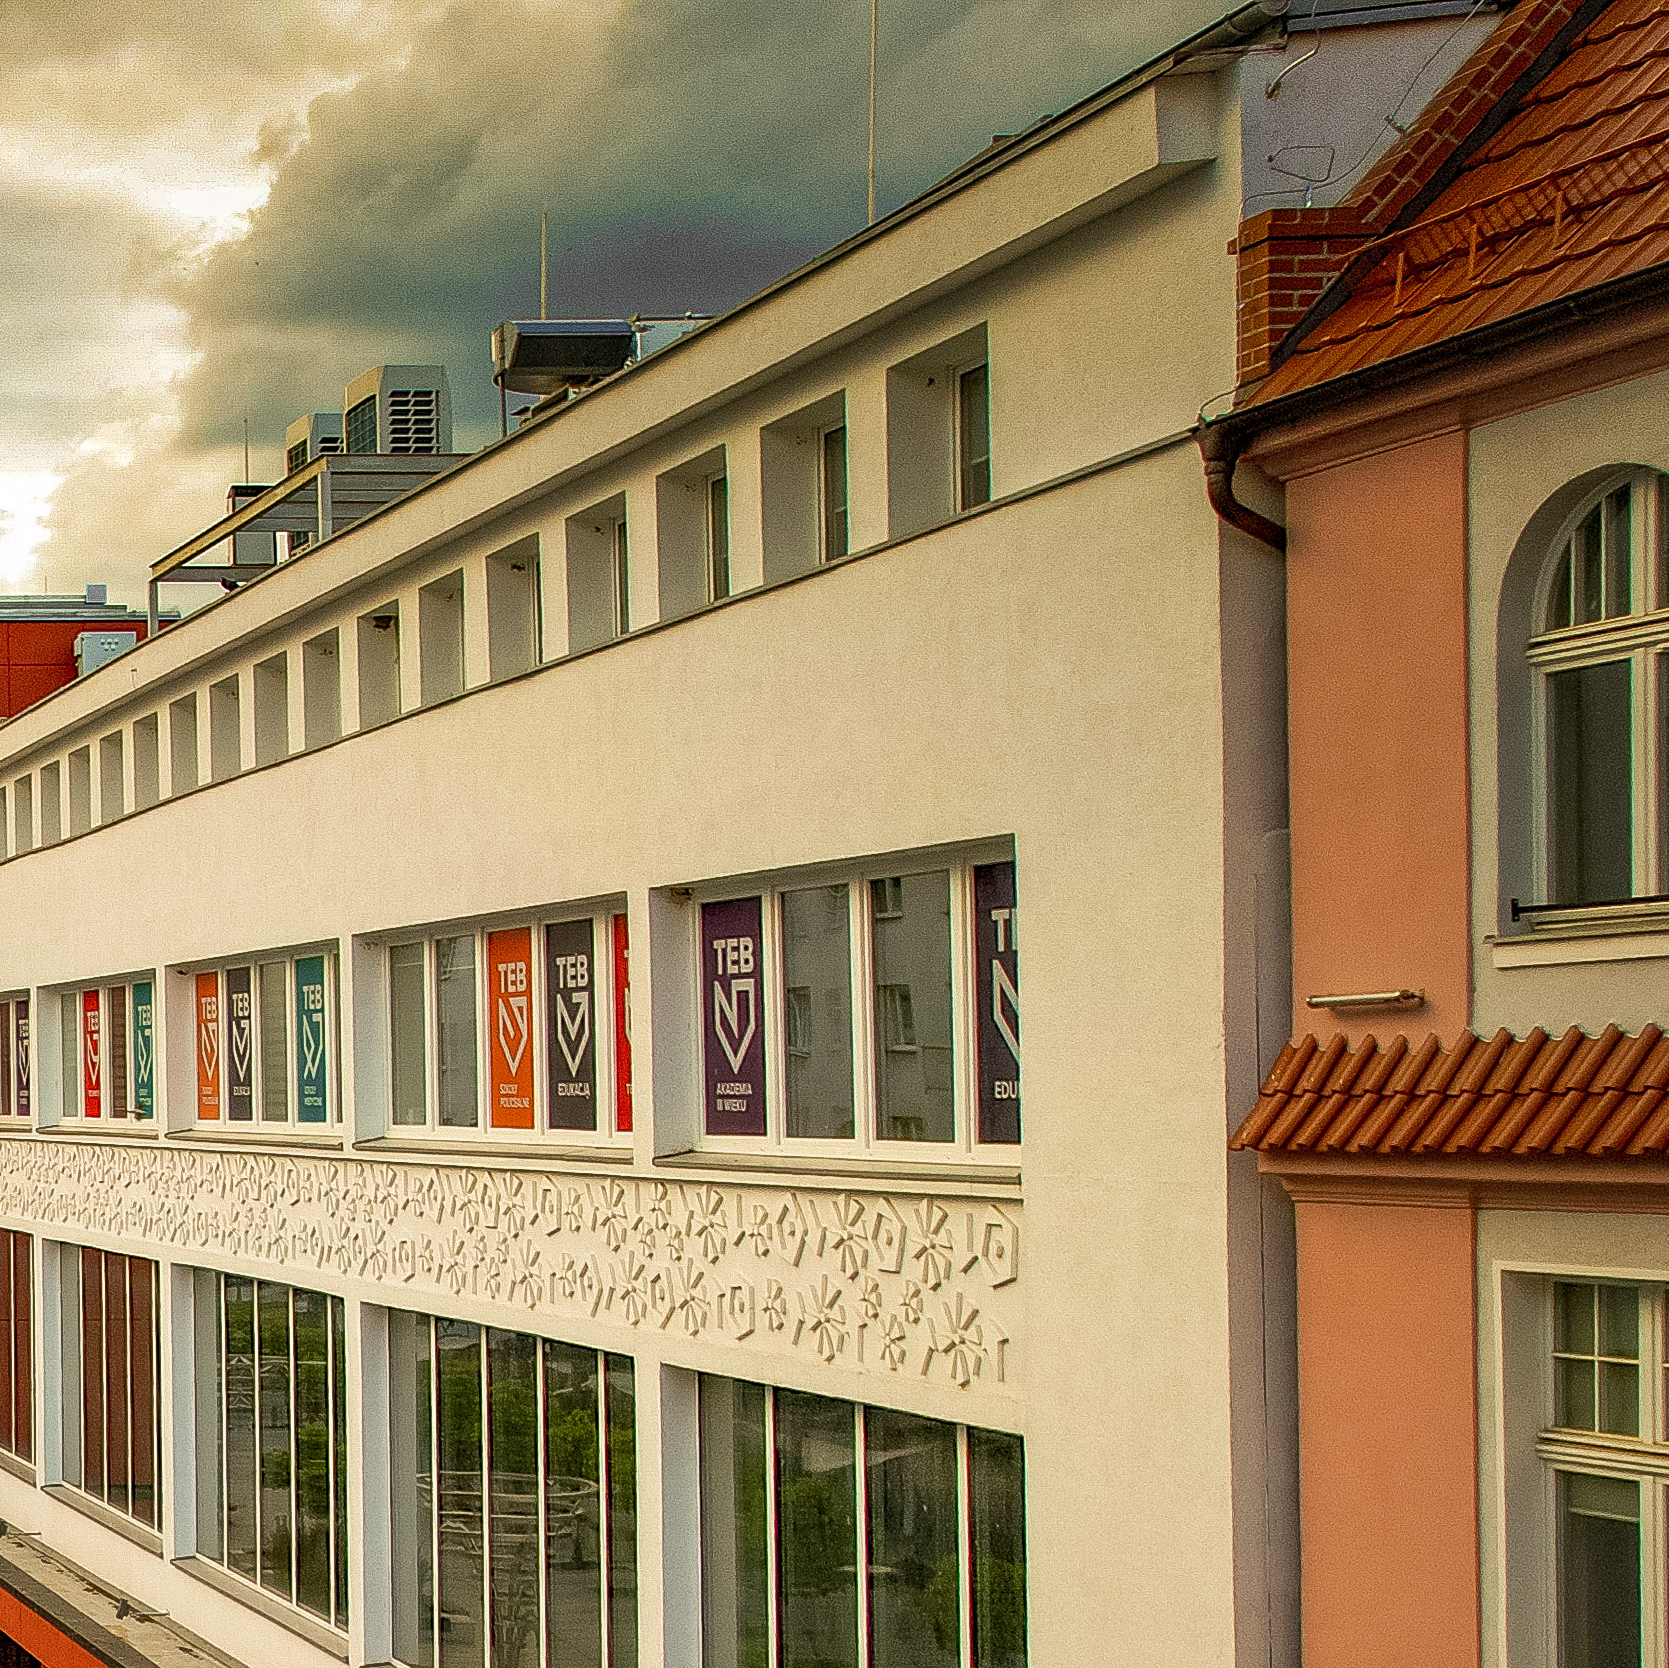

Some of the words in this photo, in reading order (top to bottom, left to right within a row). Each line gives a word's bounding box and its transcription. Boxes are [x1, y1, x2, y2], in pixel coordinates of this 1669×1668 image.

[712, 937, 753, 976] TEB
[497, 961, 528, 994] TEB
[555, 954, 589, 989] TEB
[200, 996, 218, 1019] TEB
[232, 992, 250, 1017] TEB
[302, 984, 323, 1010] TEB
[994, 1080, 1020, 1099] EDU
